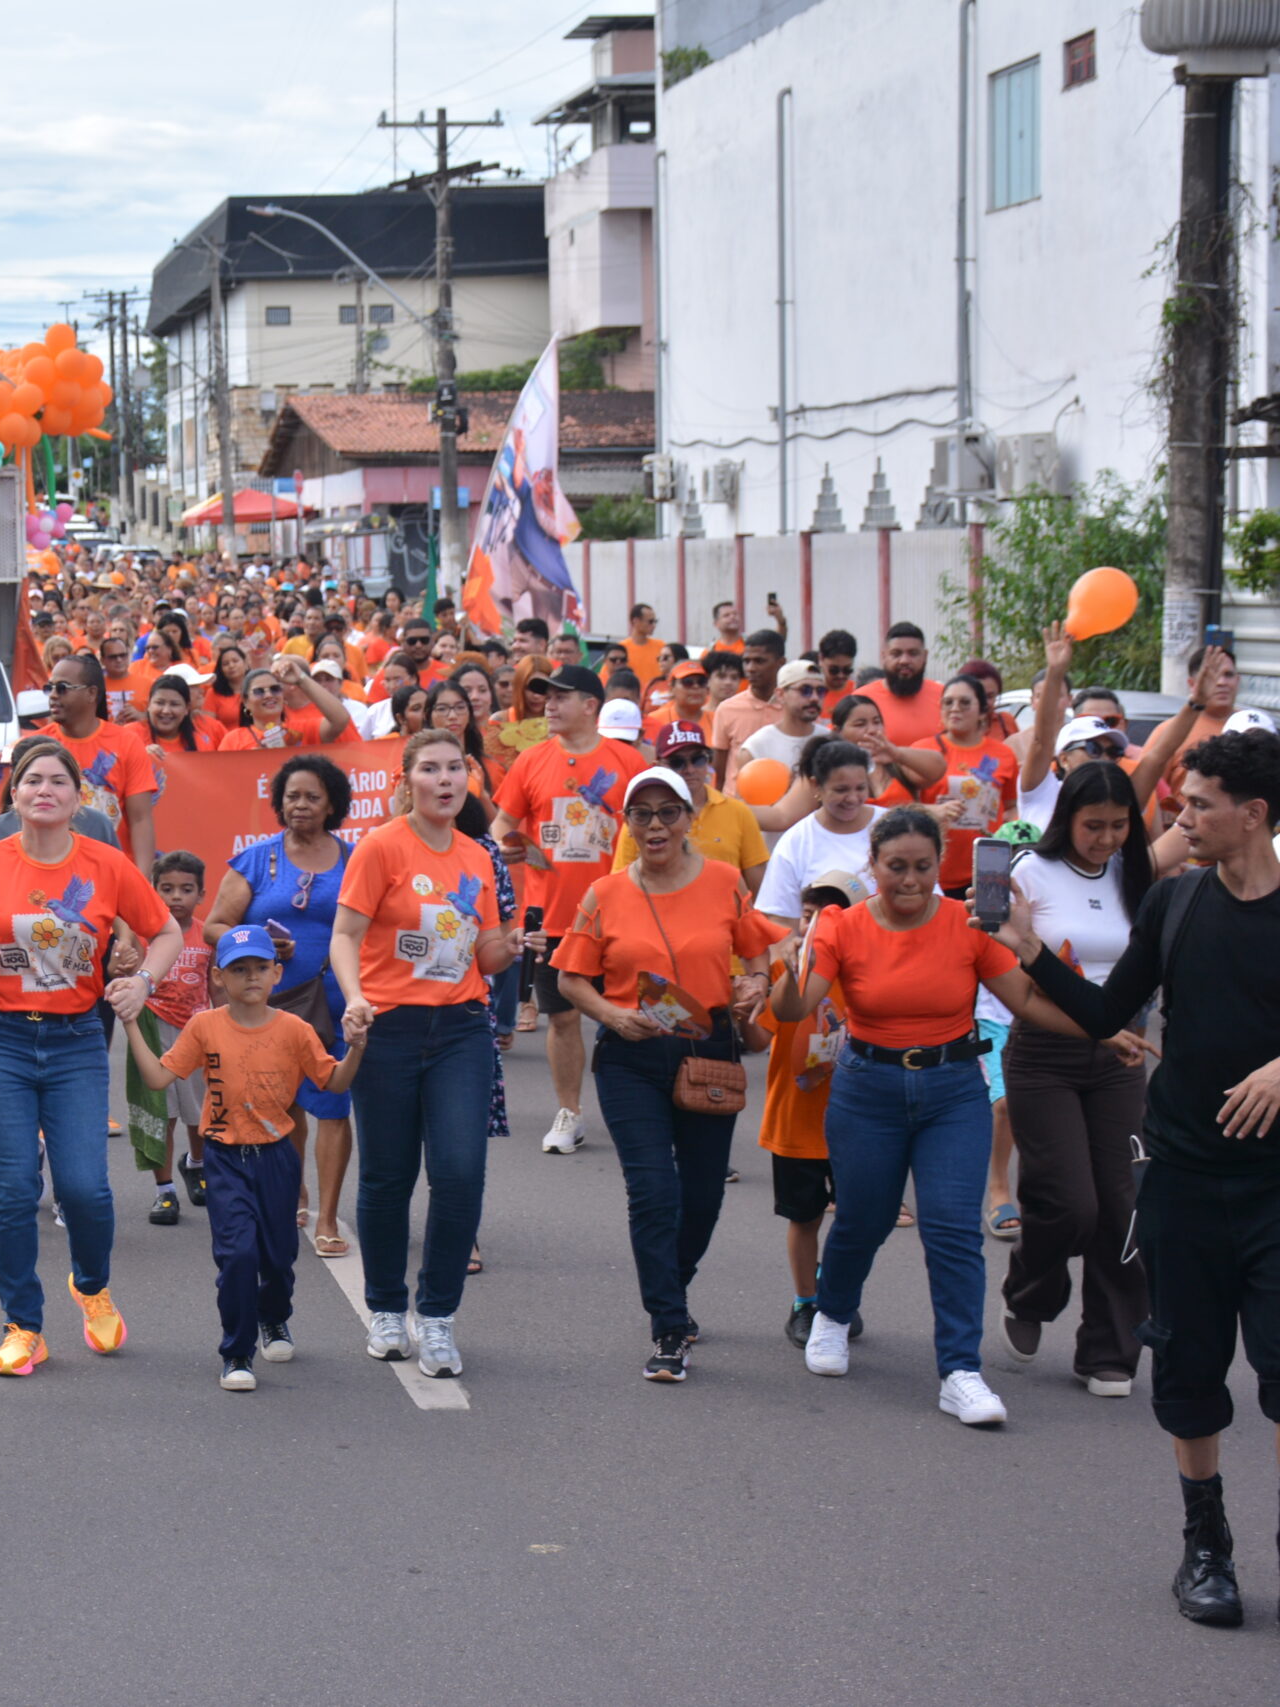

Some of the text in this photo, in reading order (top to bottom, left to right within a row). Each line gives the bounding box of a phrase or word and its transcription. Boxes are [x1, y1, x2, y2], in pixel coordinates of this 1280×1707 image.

[667, 731, 702, 745] JERI
[403, 942, 423, 953] 100
[5, 956, 25, 964] 100
